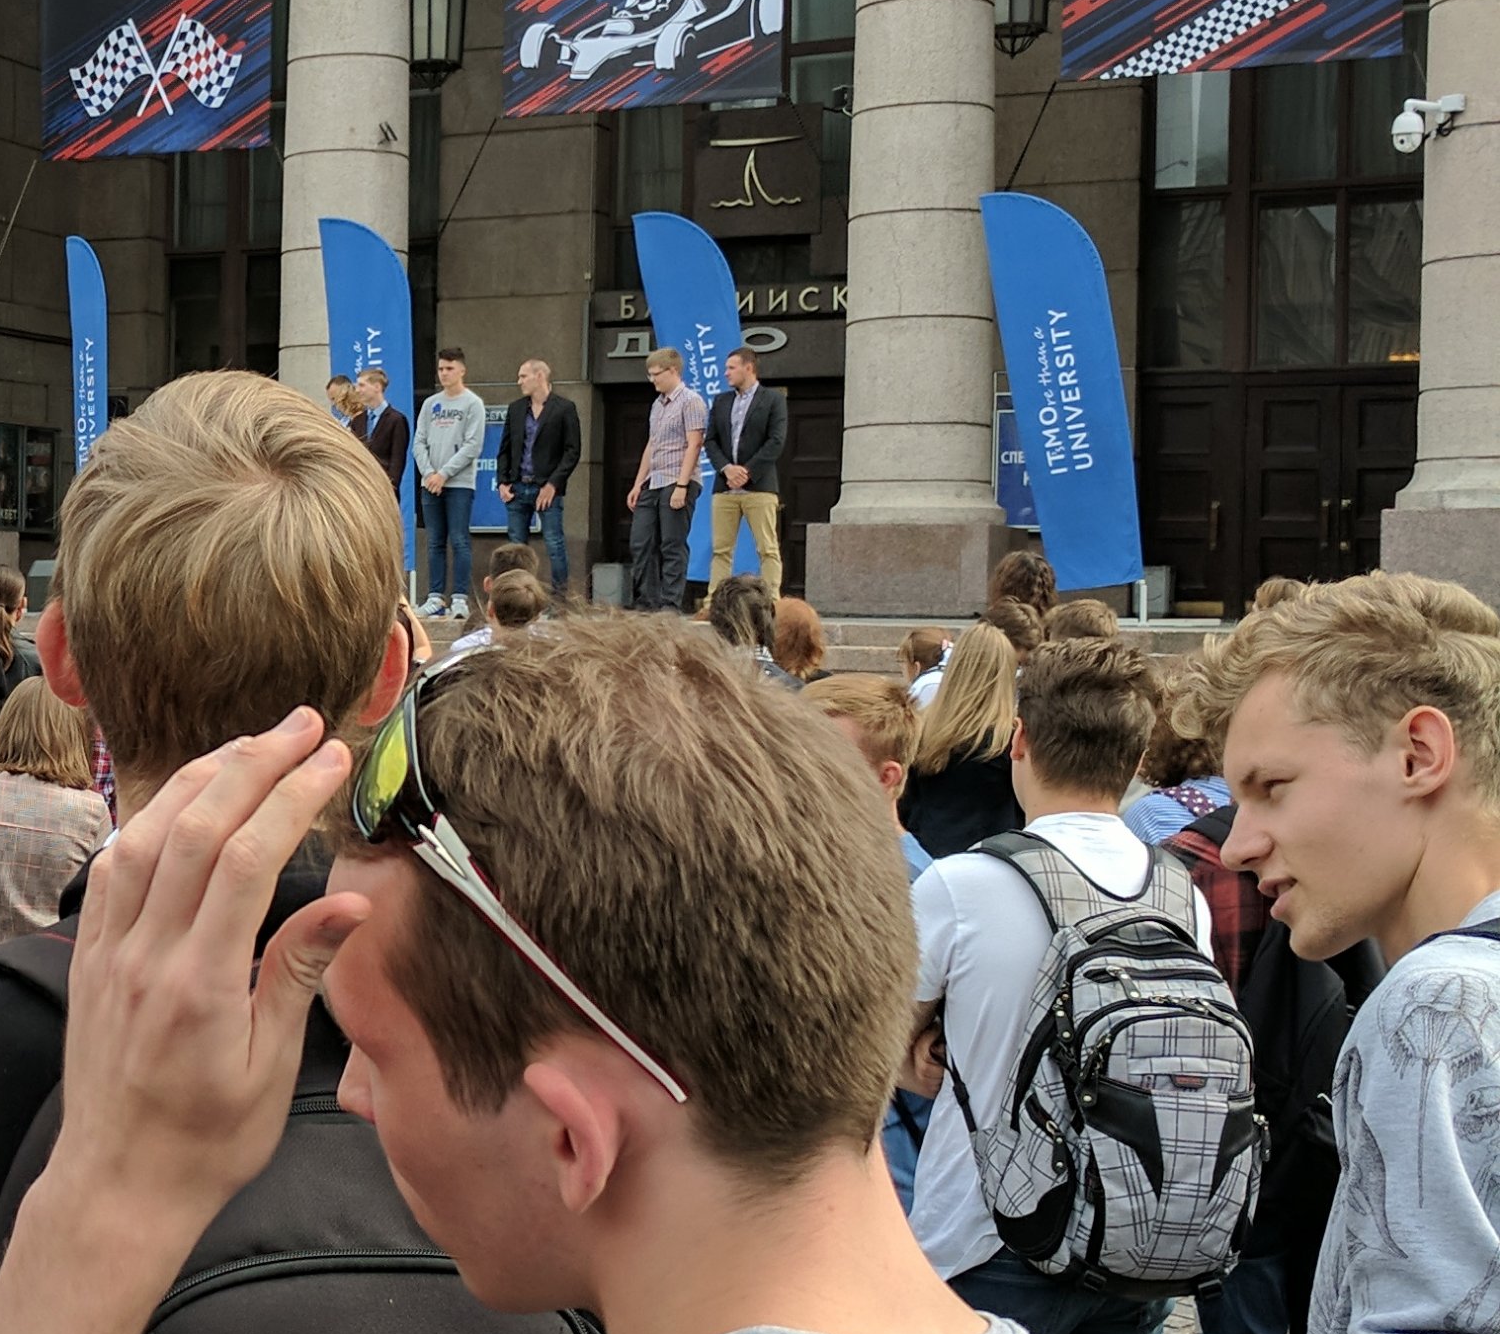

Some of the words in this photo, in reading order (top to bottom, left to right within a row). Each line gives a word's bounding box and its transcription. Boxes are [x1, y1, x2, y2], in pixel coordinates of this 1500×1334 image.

[683, 338, 695, 351] a
[1033, 326, 1044, 339] a
[1038, 341, 1052, 386] than
[85, 337, 96, 439] IVERSITY
[1047, 309, 1094, 471] UNIVERSITY
